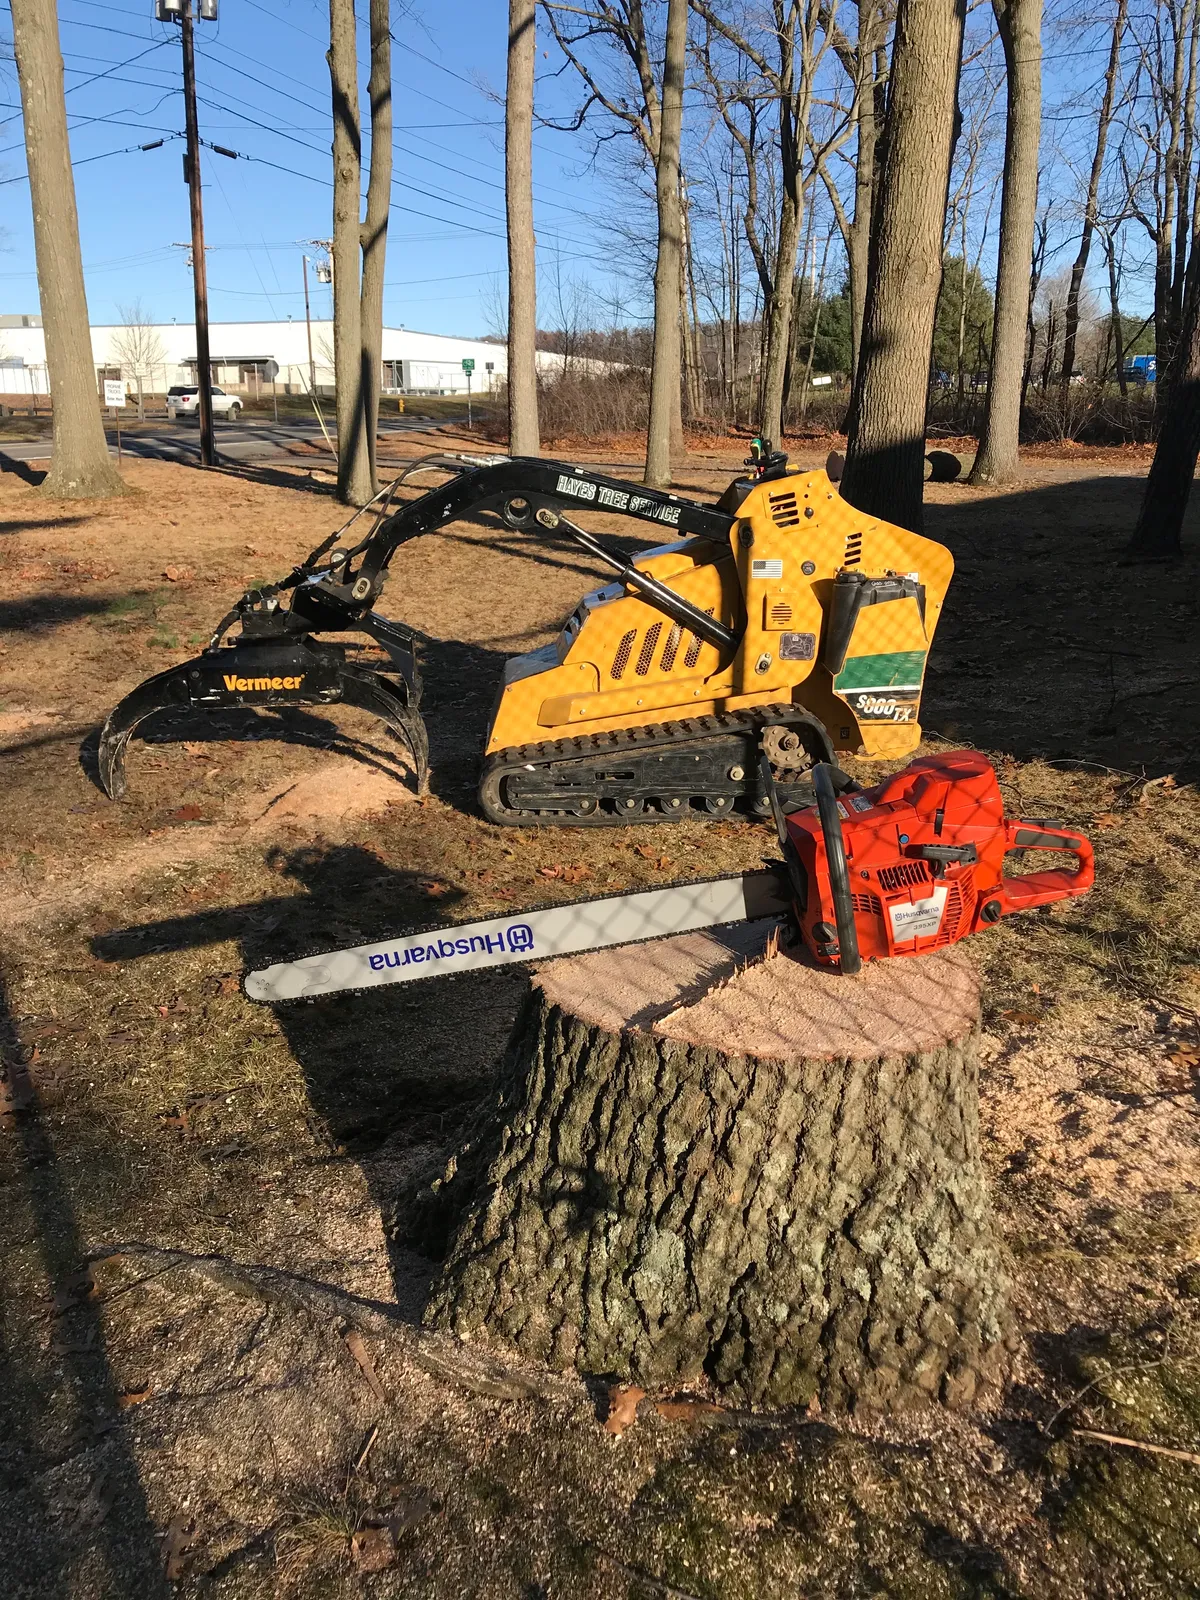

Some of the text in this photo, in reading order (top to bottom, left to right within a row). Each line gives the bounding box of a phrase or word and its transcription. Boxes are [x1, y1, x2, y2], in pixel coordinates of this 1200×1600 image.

[556, 475, 681, 524] HAYES TREE SERVICE
[223, 674, 302, 691] Vermeer
[902, 906, 940, 919] Husqvarna
[913, 921, 937, 930] 395XP
[369, 932, 505, 971] Husqvarna
